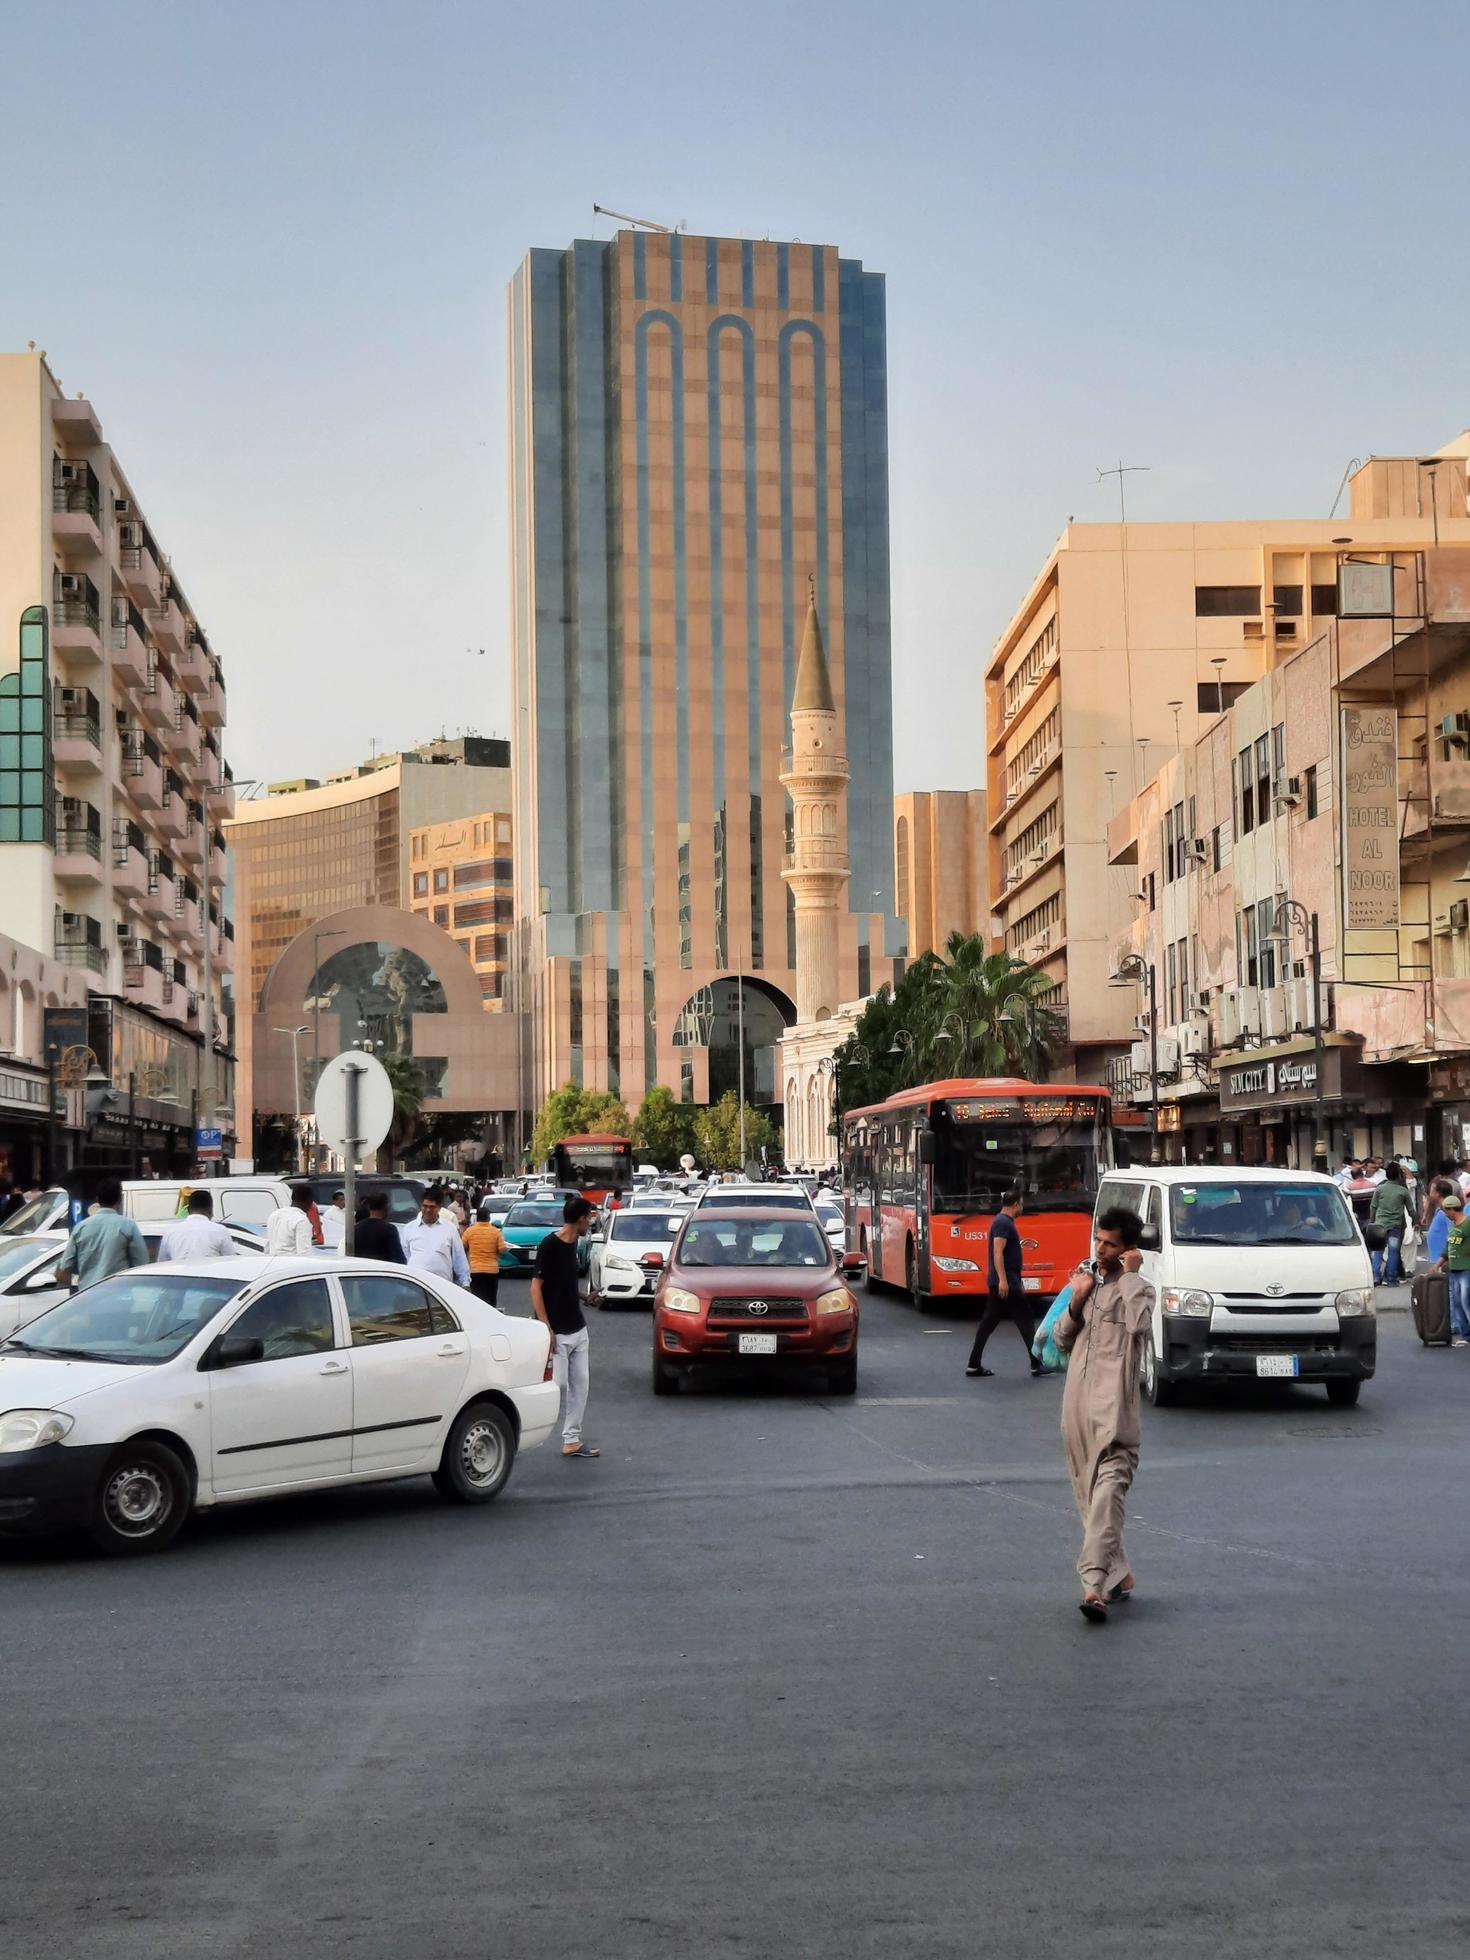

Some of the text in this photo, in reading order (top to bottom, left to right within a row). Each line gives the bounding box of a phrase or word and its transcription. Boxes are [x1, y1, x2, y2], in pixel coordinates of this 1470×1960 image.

[1348, 716, 1395, 750] فندق
[1348, 806, 1397, 828] HOTEL
[1361, 838, 1384, 859] AL
[1350, 870, 1396, 891] NOOR
